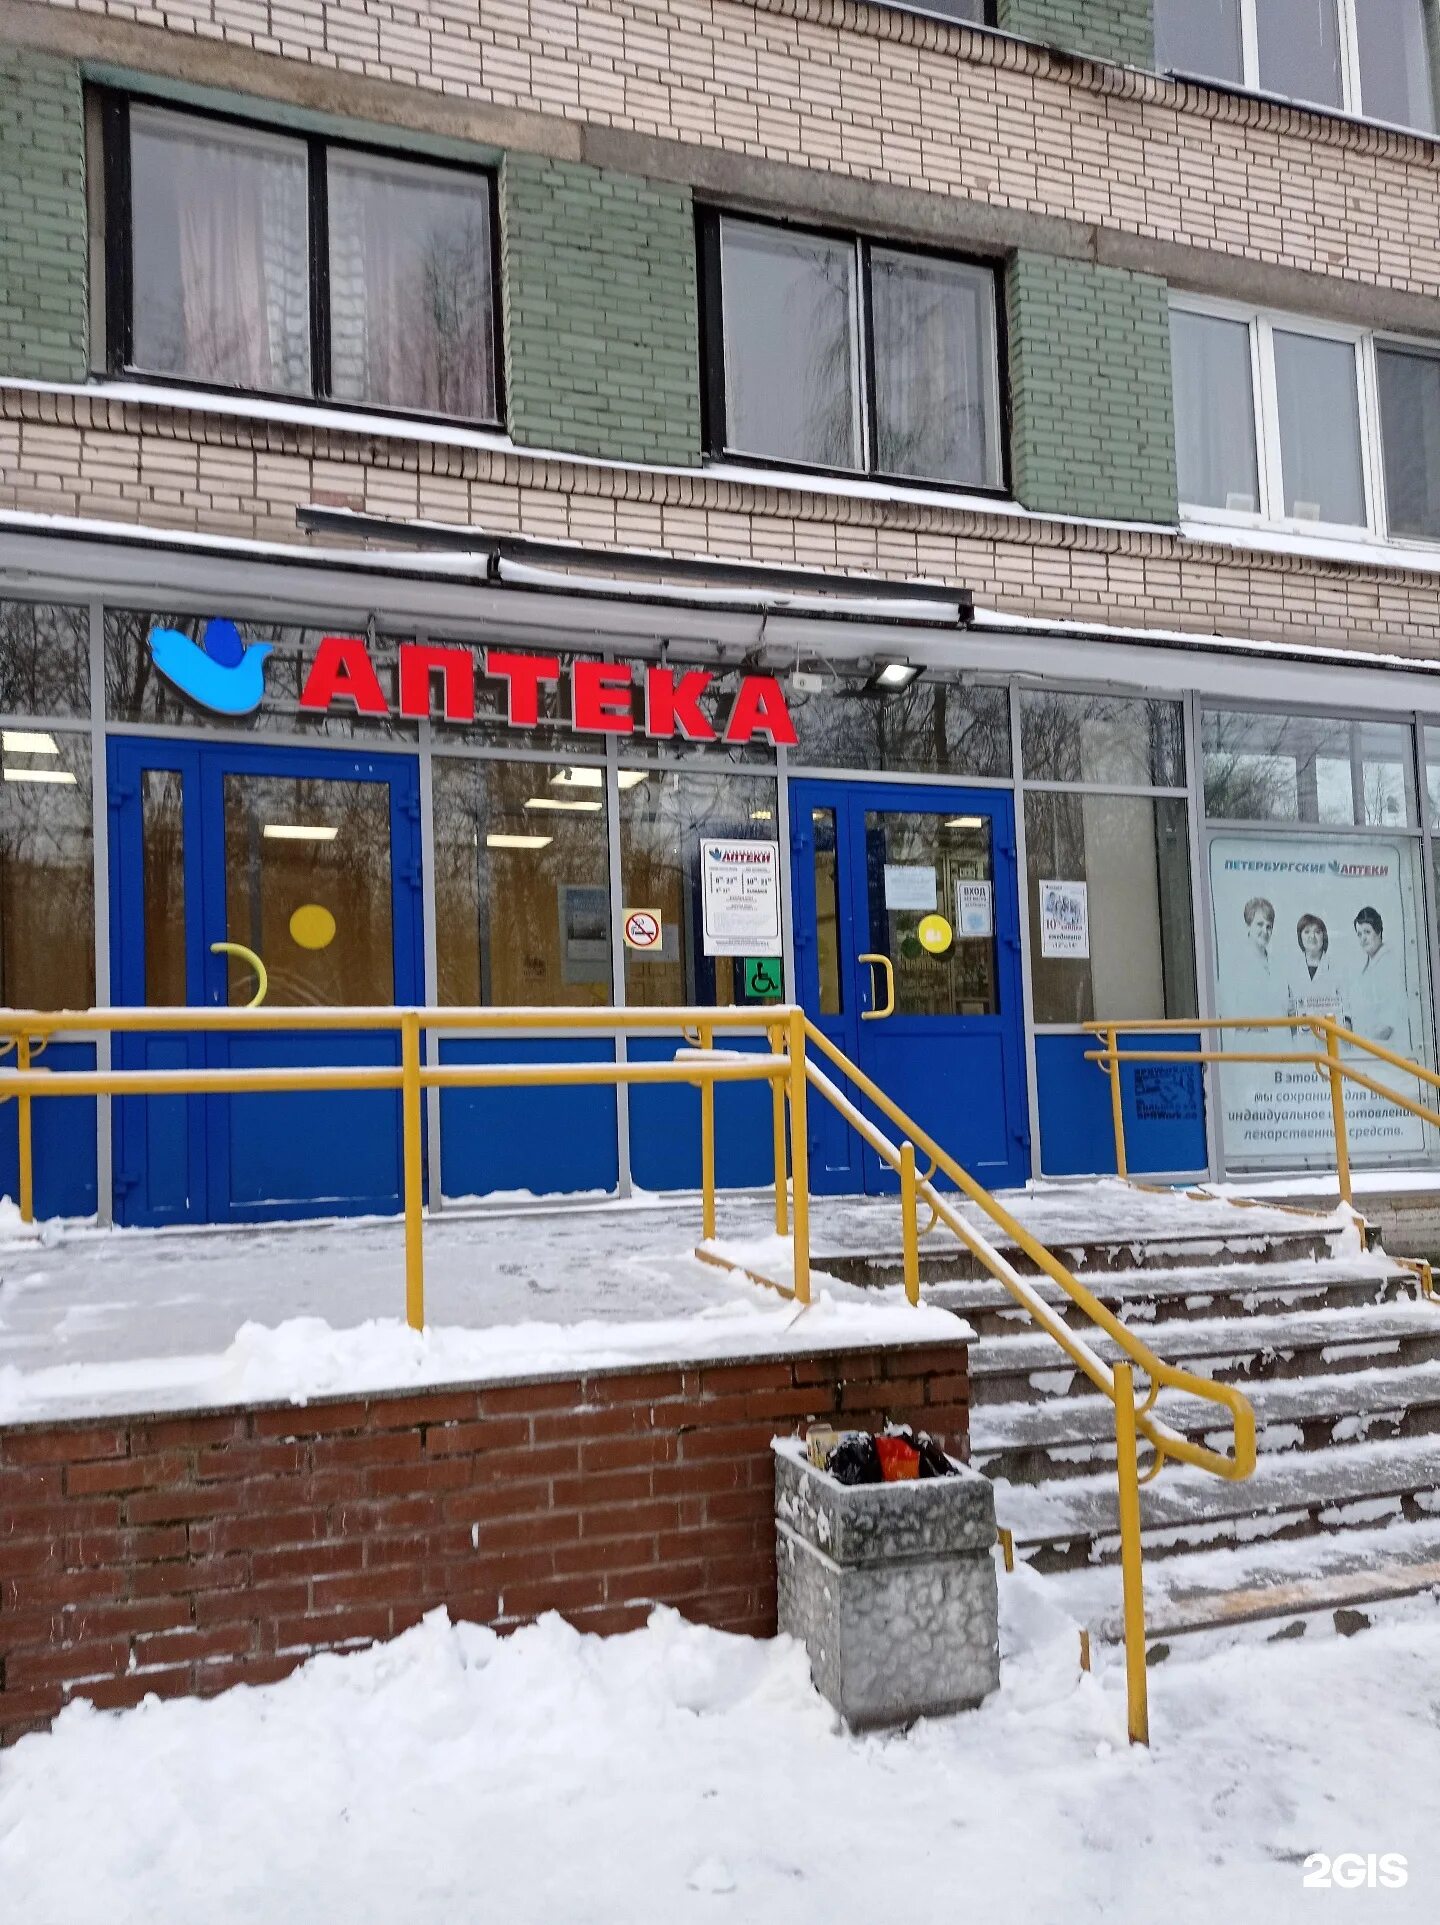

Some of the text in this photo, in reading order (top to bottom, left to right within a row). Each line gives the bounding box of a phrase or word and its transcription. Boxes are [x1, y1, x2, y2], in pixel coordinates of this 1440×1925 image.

[300, 635, 799, 746] АПТЕКА
[1224, 859, 1389, 877] ПЕТЕРБУРГСКИЕ АПТЕКИ
[963, 887, 986, 897] ВХОД
[1274, 1072, 1282, 1084] В
[1285, 1071, 1318, 1084] этой
[1254, 1092, 1273, 1102] мы
[1276, 1092, 1332, 1103] сохрани
[1345, 1089, 1367, 1101] для
